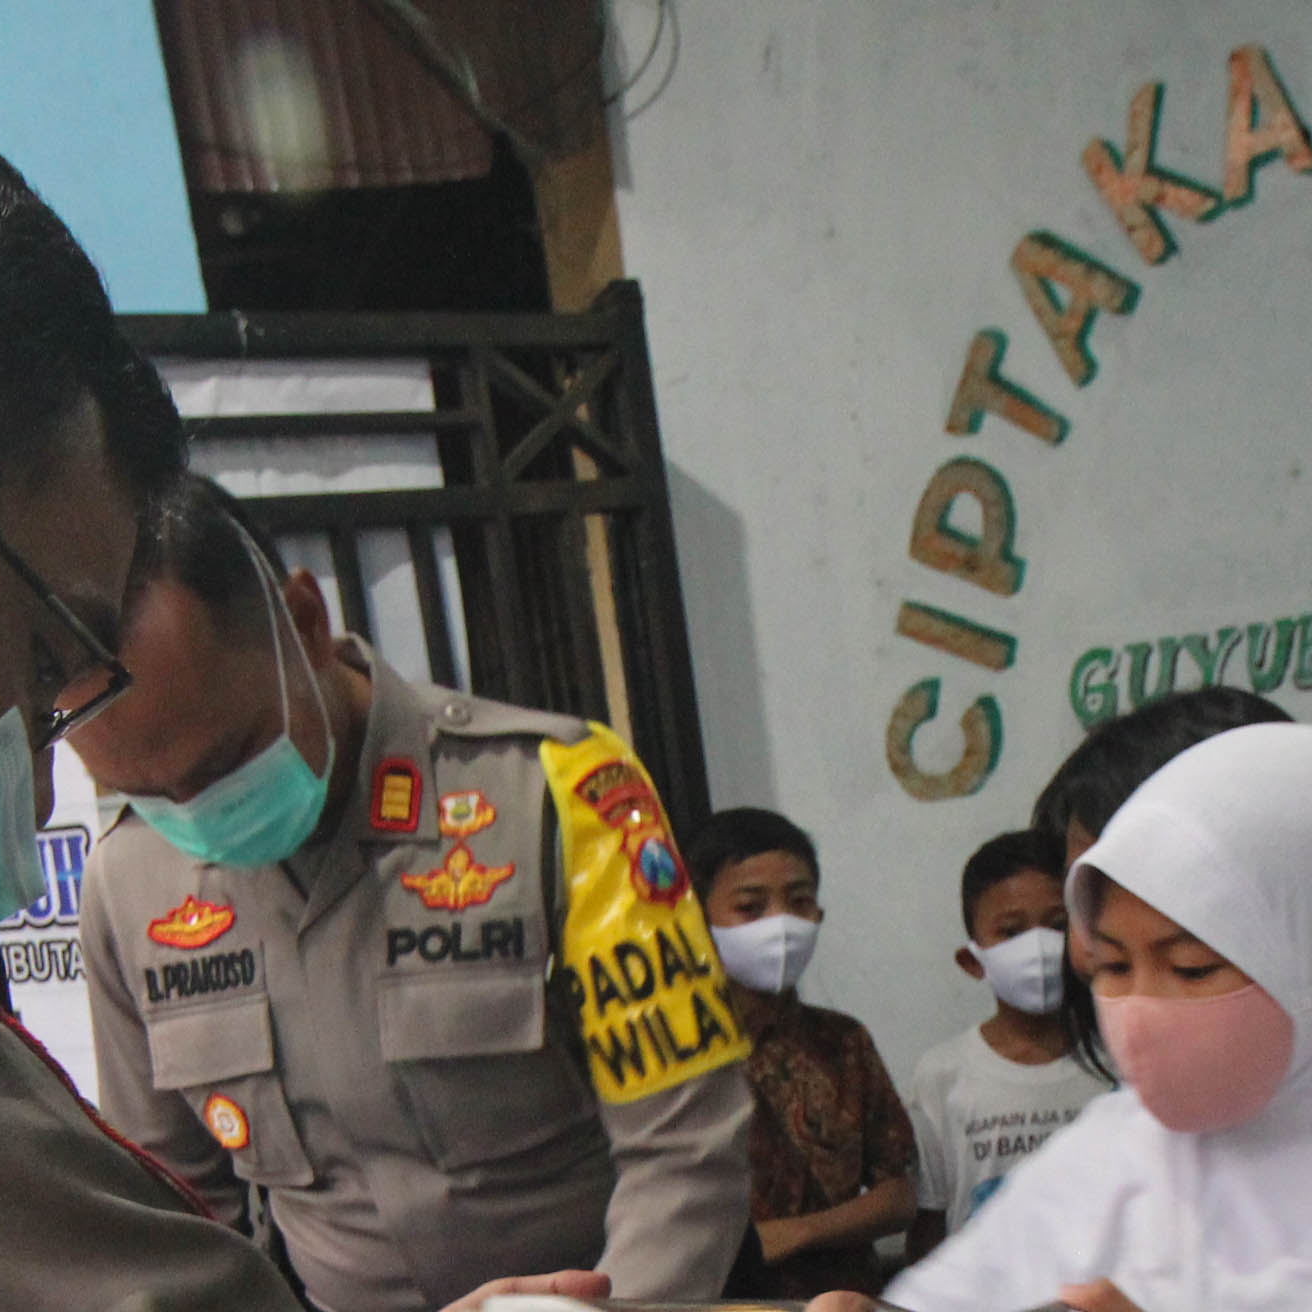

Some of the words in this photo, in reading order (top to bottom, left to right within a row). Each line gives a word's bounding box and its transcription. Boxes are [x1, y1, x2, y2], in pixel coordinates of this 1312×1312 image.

[2, 939, 90, 987] BUTA
[387, 917, 524, 966] POLRI
[589, 990, 732, 1088] WILA
[996, 1133, 1046, 1156] BAN
